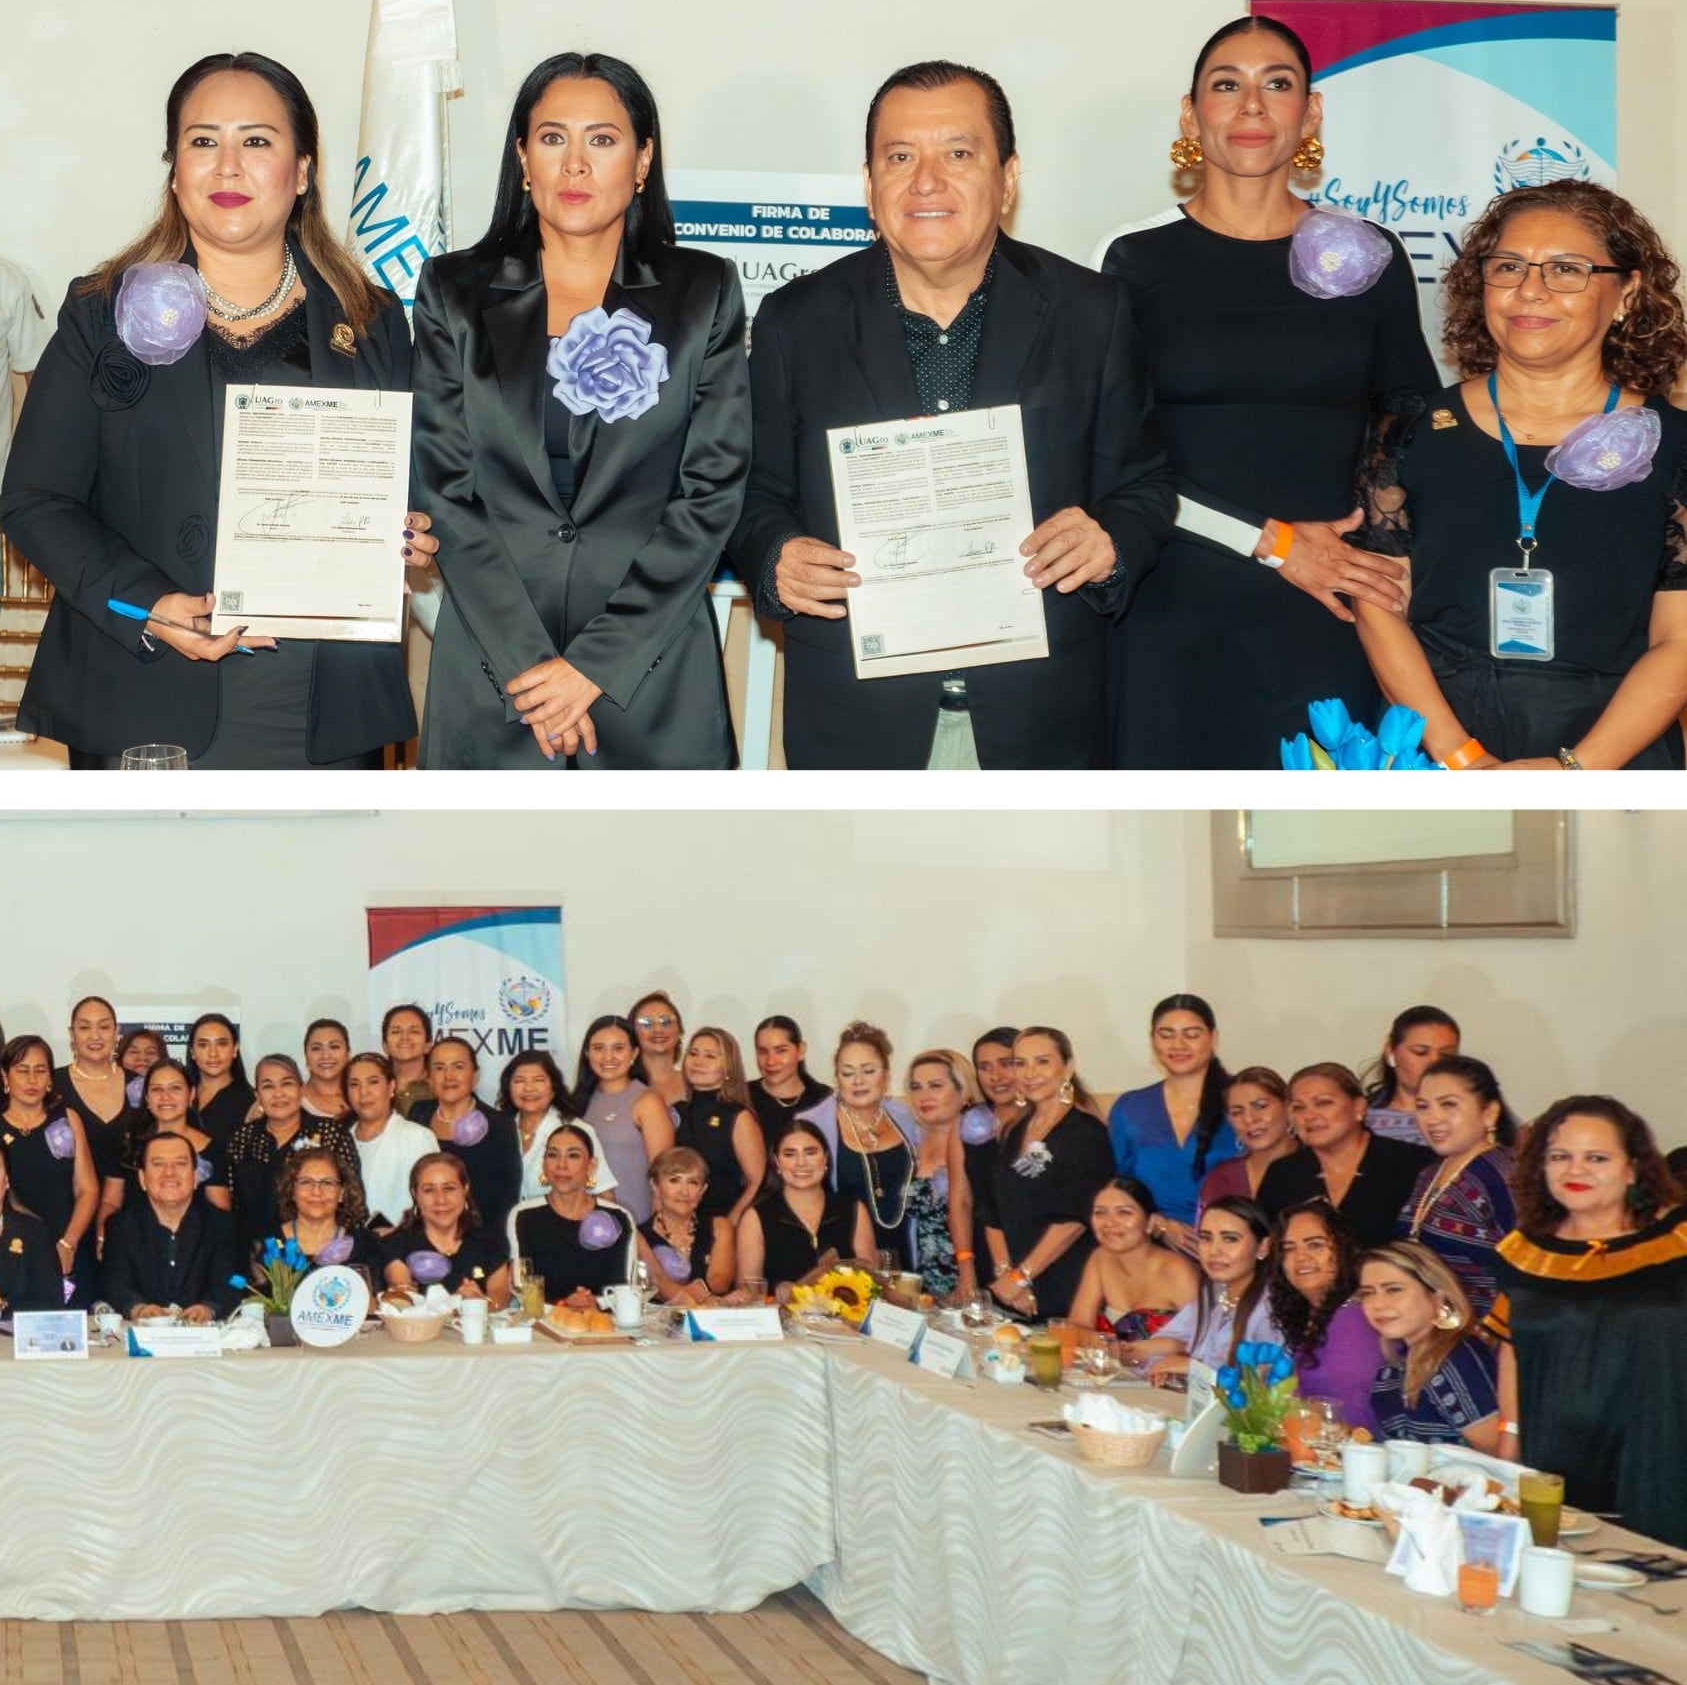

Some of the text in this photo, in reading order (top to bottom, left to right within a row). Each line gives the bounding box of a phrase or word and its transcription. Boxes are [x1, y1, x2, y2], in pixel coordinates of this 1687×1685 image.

[752, 204, 831, 221] FIRMA DE
[674, 222, 880, 242] CONVENIO DE COLABORA
[305, 399, 339, 409] AMEXME
[911, 429, 945, 440] AMEXME
[297, 1310, 354, 1326] AMEXME
